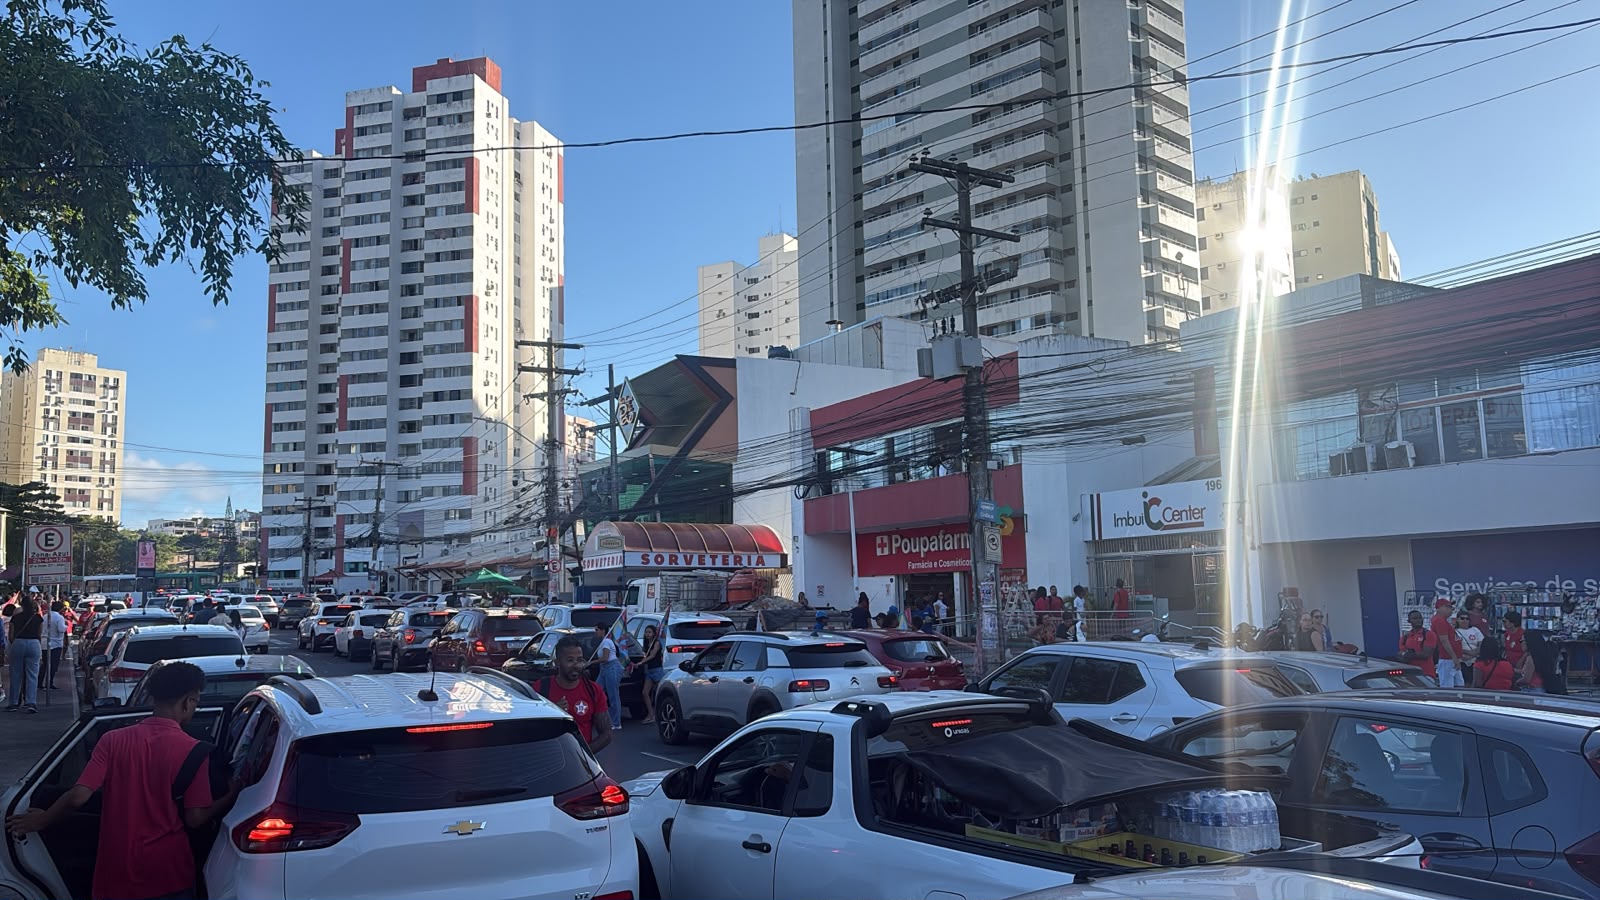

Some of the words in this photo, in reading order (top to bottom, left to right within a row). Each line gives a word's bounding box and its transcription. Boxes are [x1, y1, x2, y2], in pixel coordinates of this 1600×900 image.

[1113, 511, 1144, 528] Imbui
[1162, 504, 1206, 523] Center
[44, 532, 55, 547] E
[891, 530, 970, 558] Poupafarm
[583, 555, 623, 569] SORVETERIA
[641, 552, 766, 566] SORVETERIA
[908, 561, 933, 569] Farmácia
[1545, 574, 1577, 597] de
[1583, 578, 1600, 596] s
